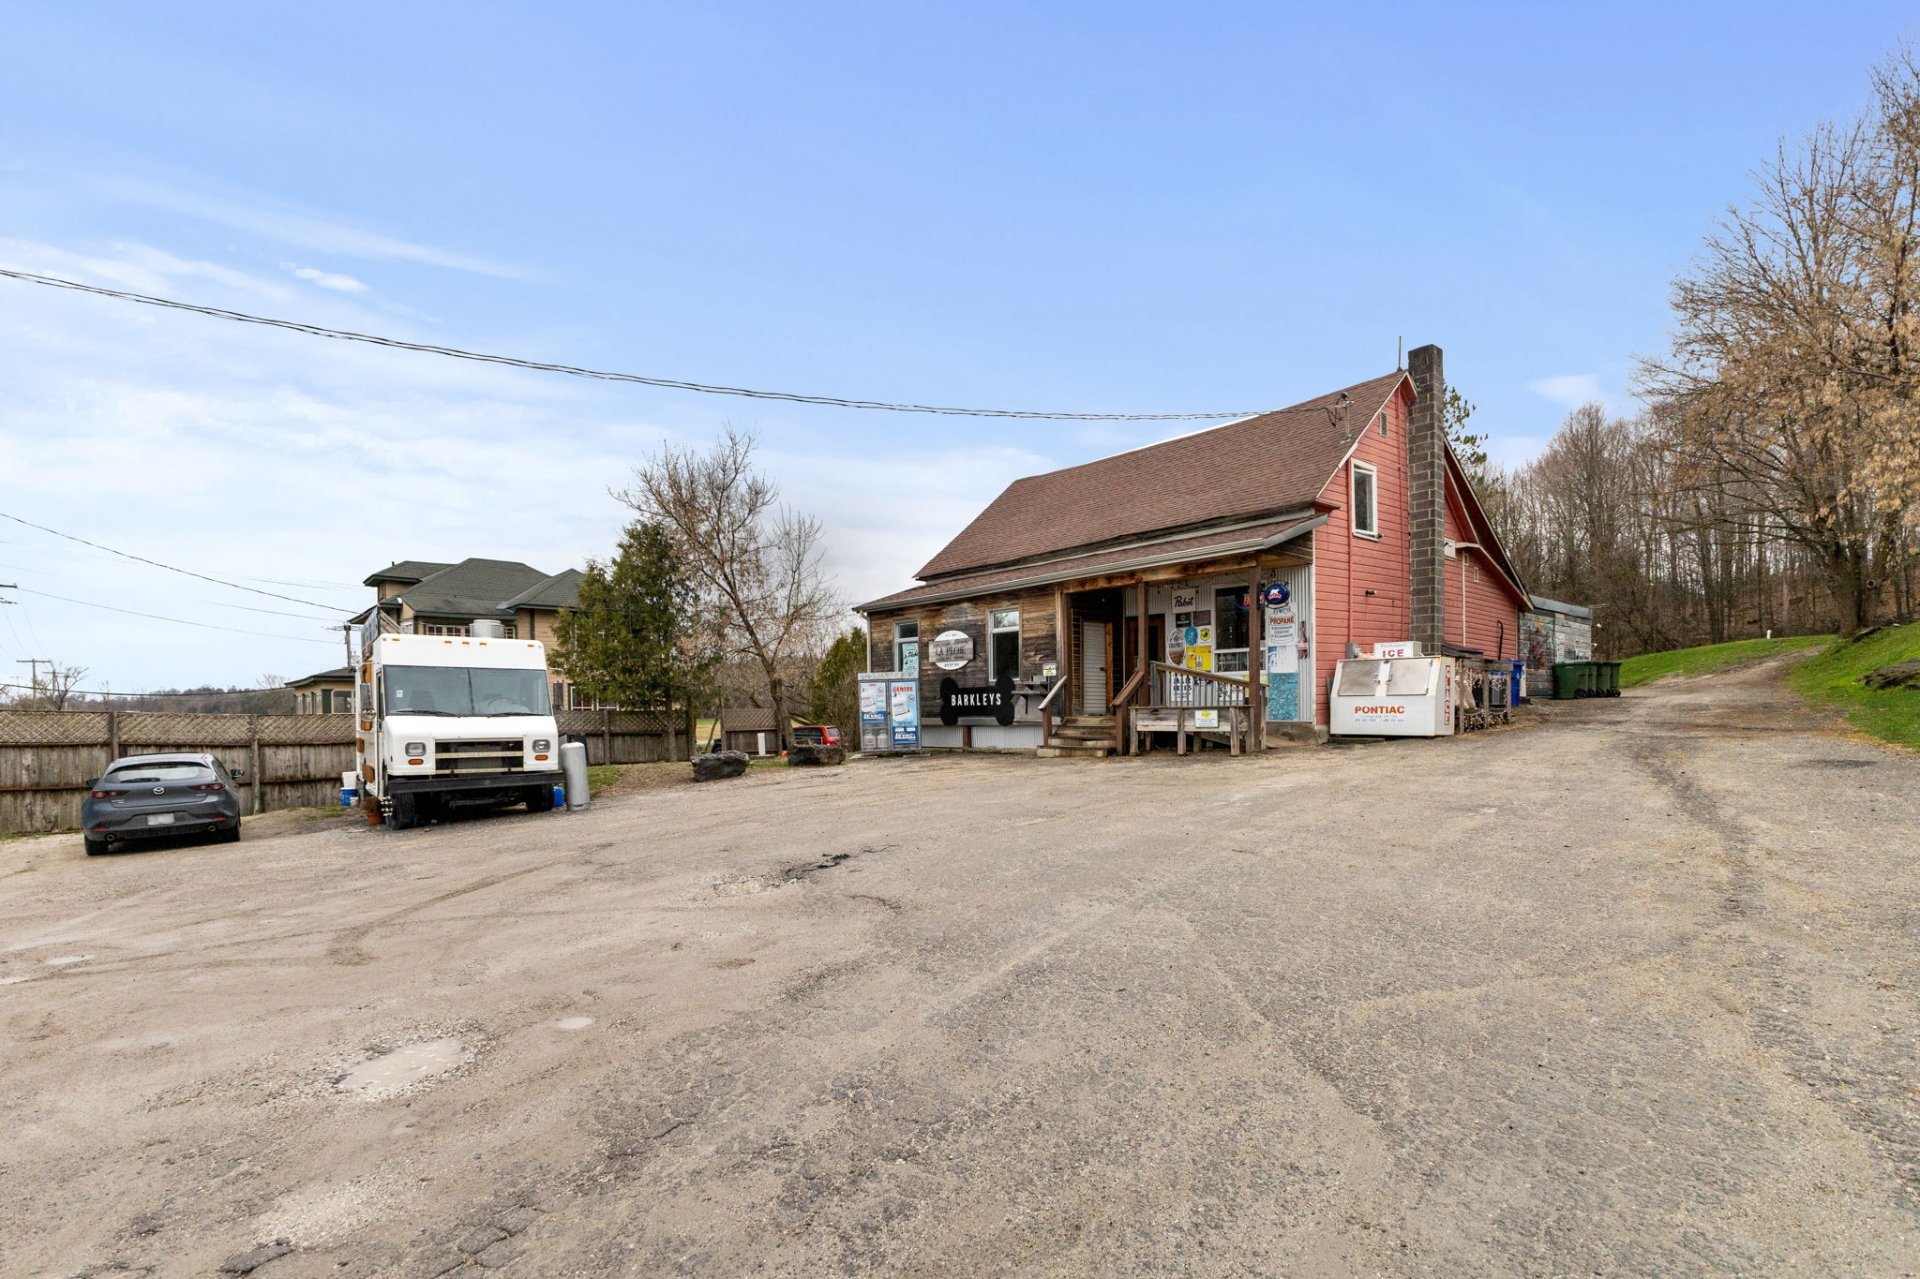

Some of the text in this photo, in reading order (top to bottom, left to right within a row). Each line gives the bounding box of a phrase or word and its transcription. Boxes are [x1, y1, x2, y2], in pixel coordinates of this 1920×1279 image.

[1269, 617, 1295, 625] PROPANE
[1382, 649, 1405, 658] ICE
[951, 692, 1001, 706] BARKLEYS
[1354, 705, 1405, 714] PONTIAC
